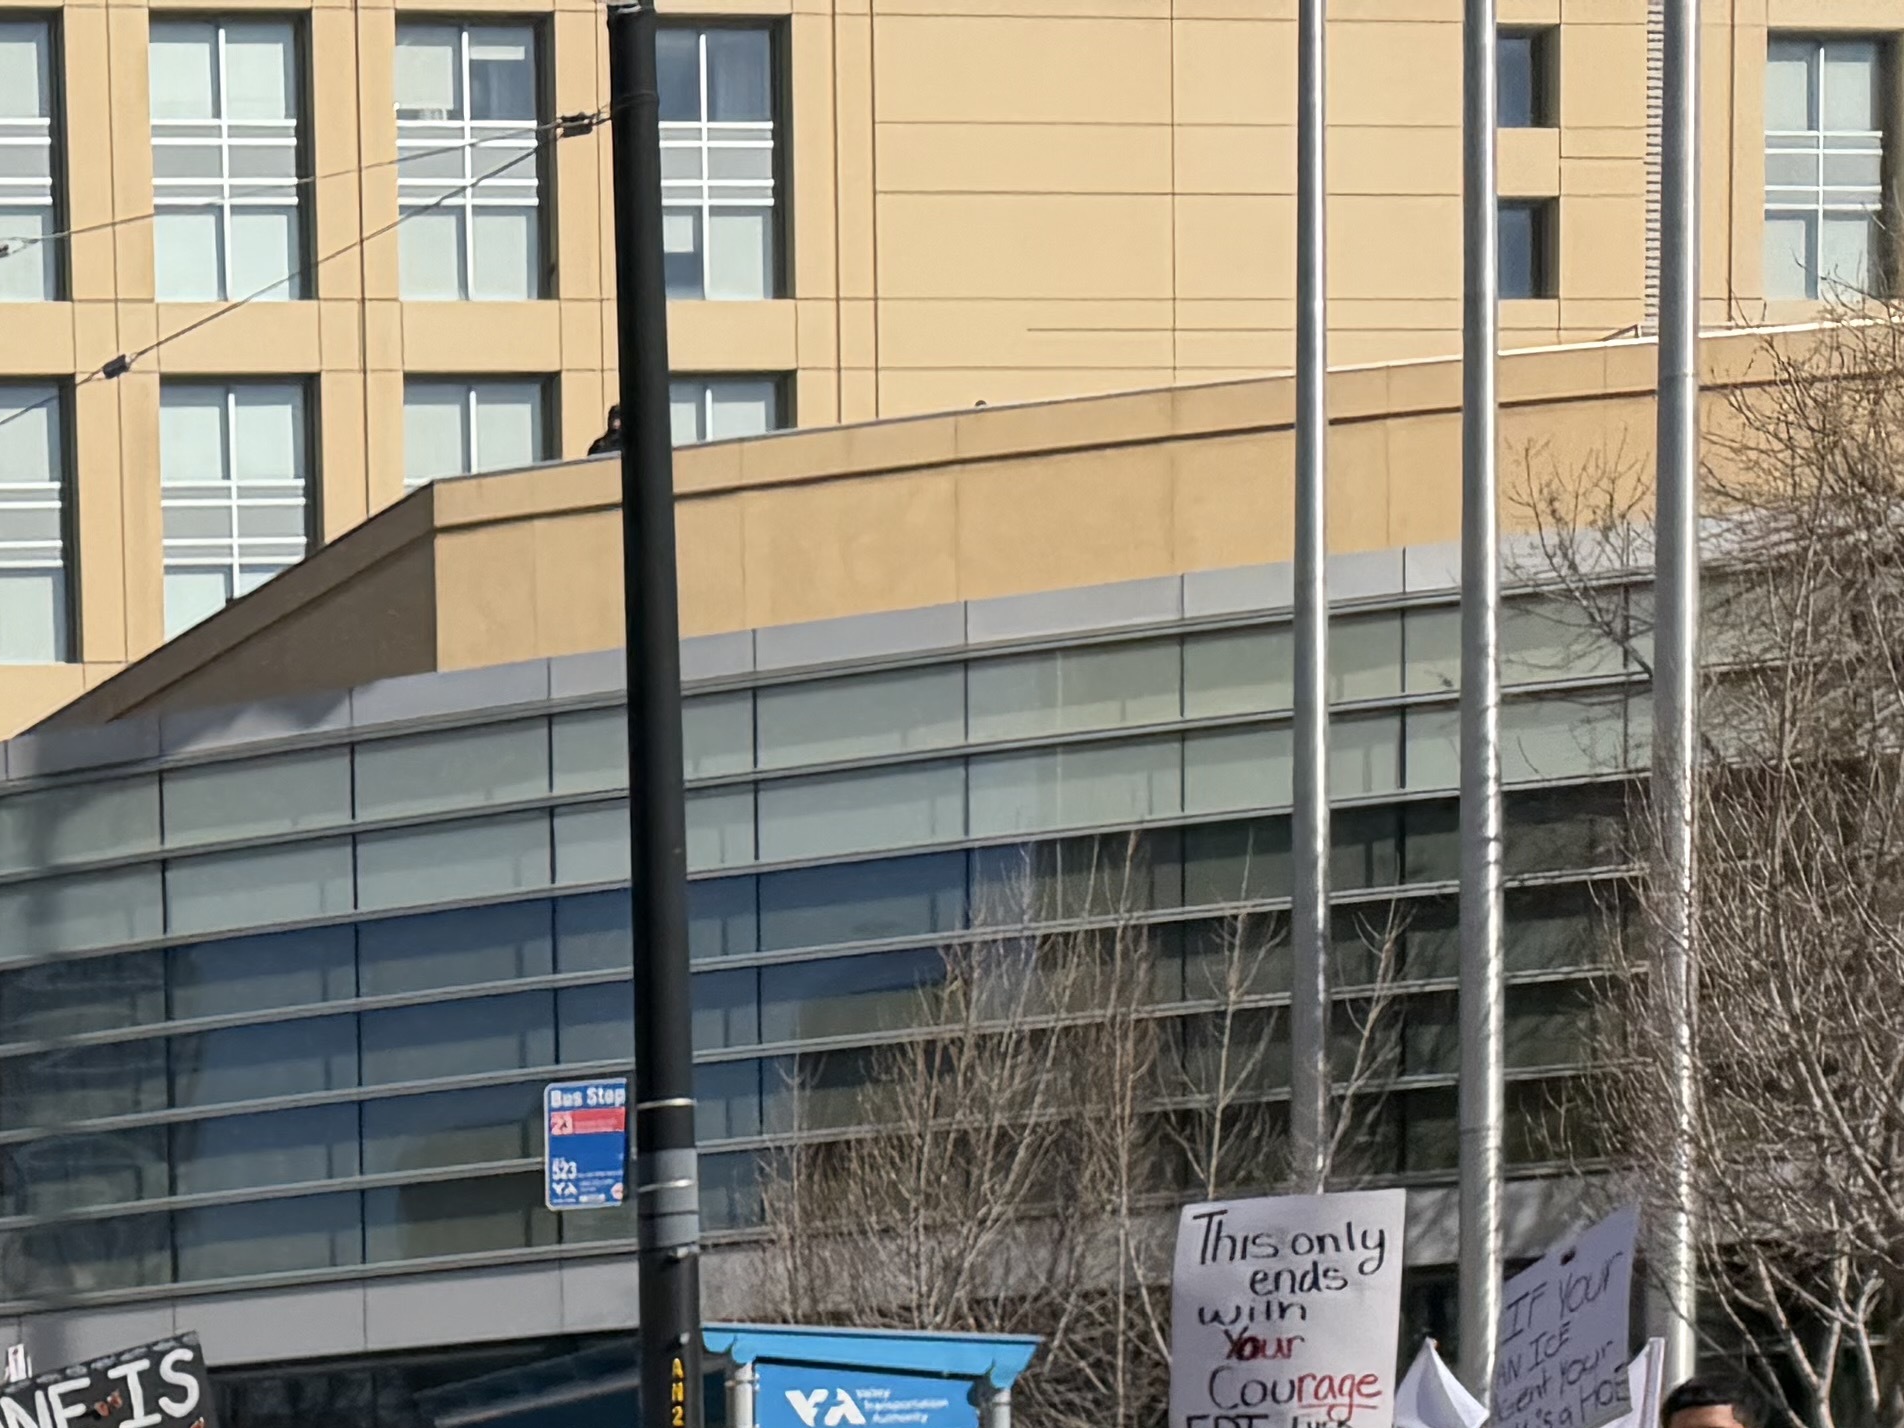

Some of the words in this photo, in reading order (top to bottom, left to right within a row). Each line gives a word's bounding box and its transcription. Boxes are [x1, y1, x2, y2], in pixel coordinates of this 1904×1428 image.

[551, 1089, 583, 1108] Bus
[587, 1086, 626, 1107] Stop
[1193, 1209, 1279, 1265] This
[1291, 1221, 1385, 1276] only
[1249, 1260, 1348, 1296] ends
[1198, 1300, 1307, 1326] with
[1208, 1365, 1382, 1423] Courage
